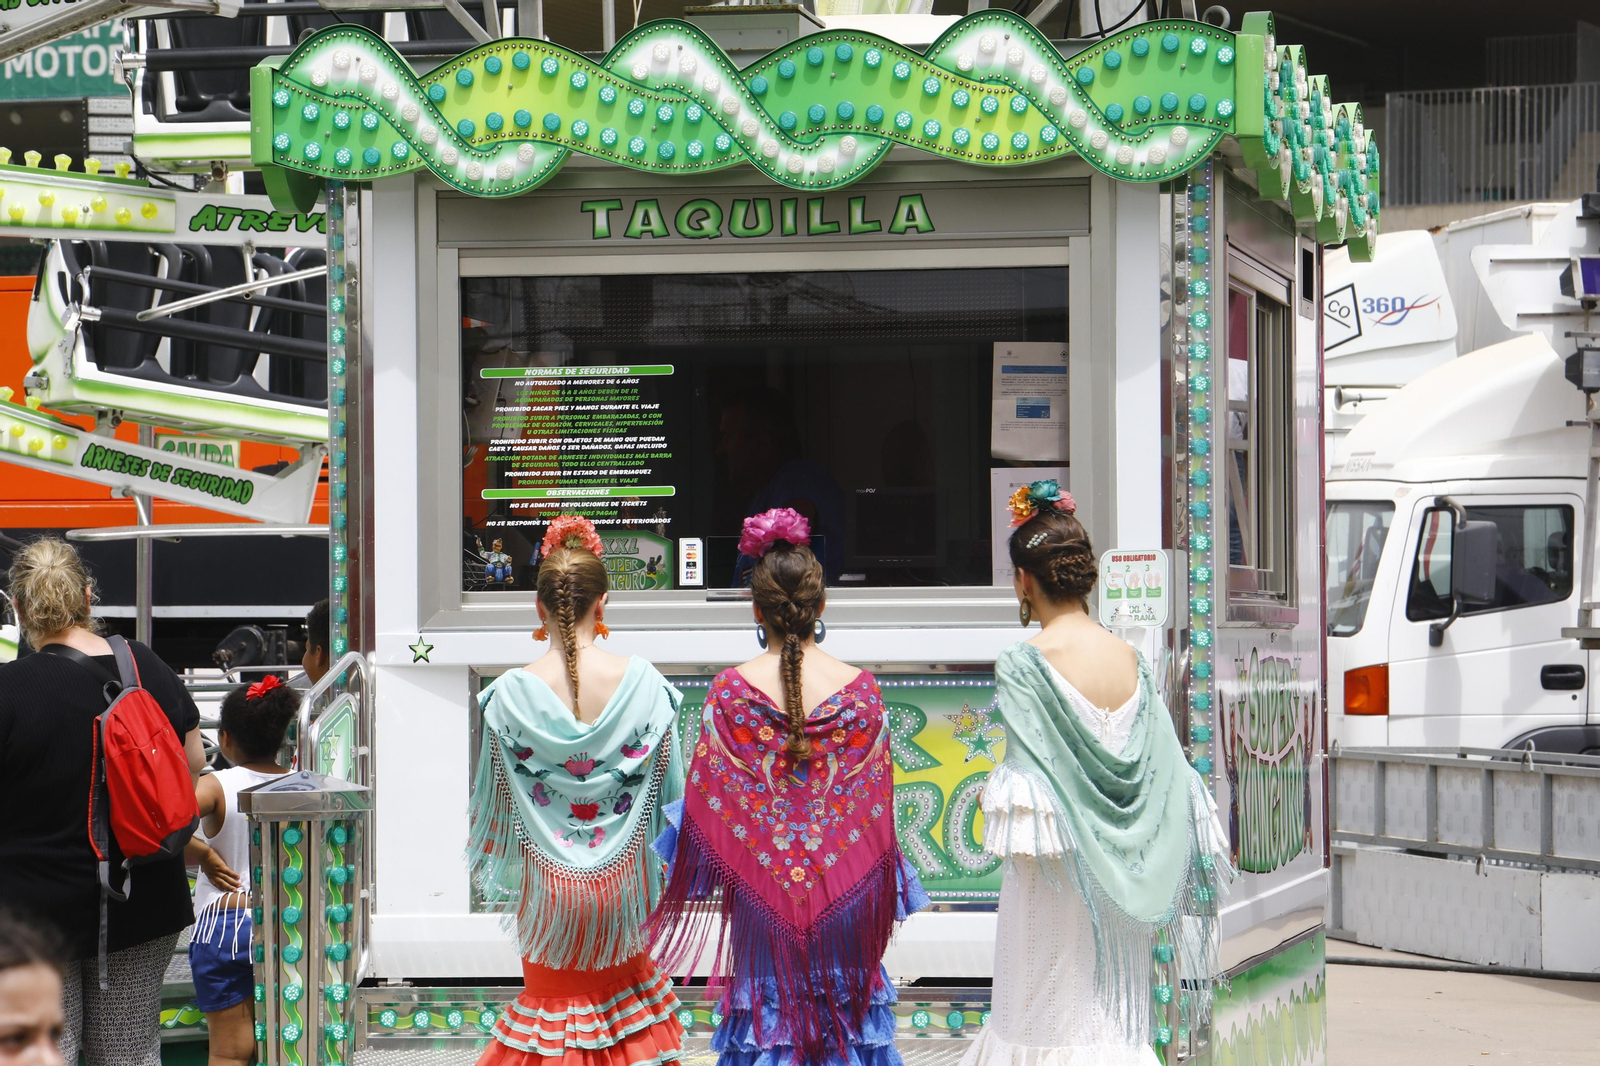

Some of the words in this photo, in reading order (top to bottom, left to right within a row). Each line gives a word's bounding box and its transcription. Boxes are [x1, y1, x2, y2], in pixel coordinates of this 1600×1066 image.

[580, 193, 935, 240] TAQUILLA
[1362, 296, 1405, 313] 360
[524, 368, 563, 376] NORMAS
[579, 367, 630, 375] SEGURIDAD
[81, 443, 150, 477] ARNESES
[151, 462, 173, 482] DE
[171, 468, 254, 504] SEGURIDAD
[546, 488, 610, 496] OBSERVACIONES
[601, 538, 639, 555] XXL
[1123, 554, 1156, 562] OBLIGATORIO
[1125, 565, 1131, 573] 2
[1145, 564, 1150, 572] 3
[607, 570, 646, 590] NGURO
[1250, 647, 1295, 756] SUPER
[1236, 733, 1304, 873] KANGURO
